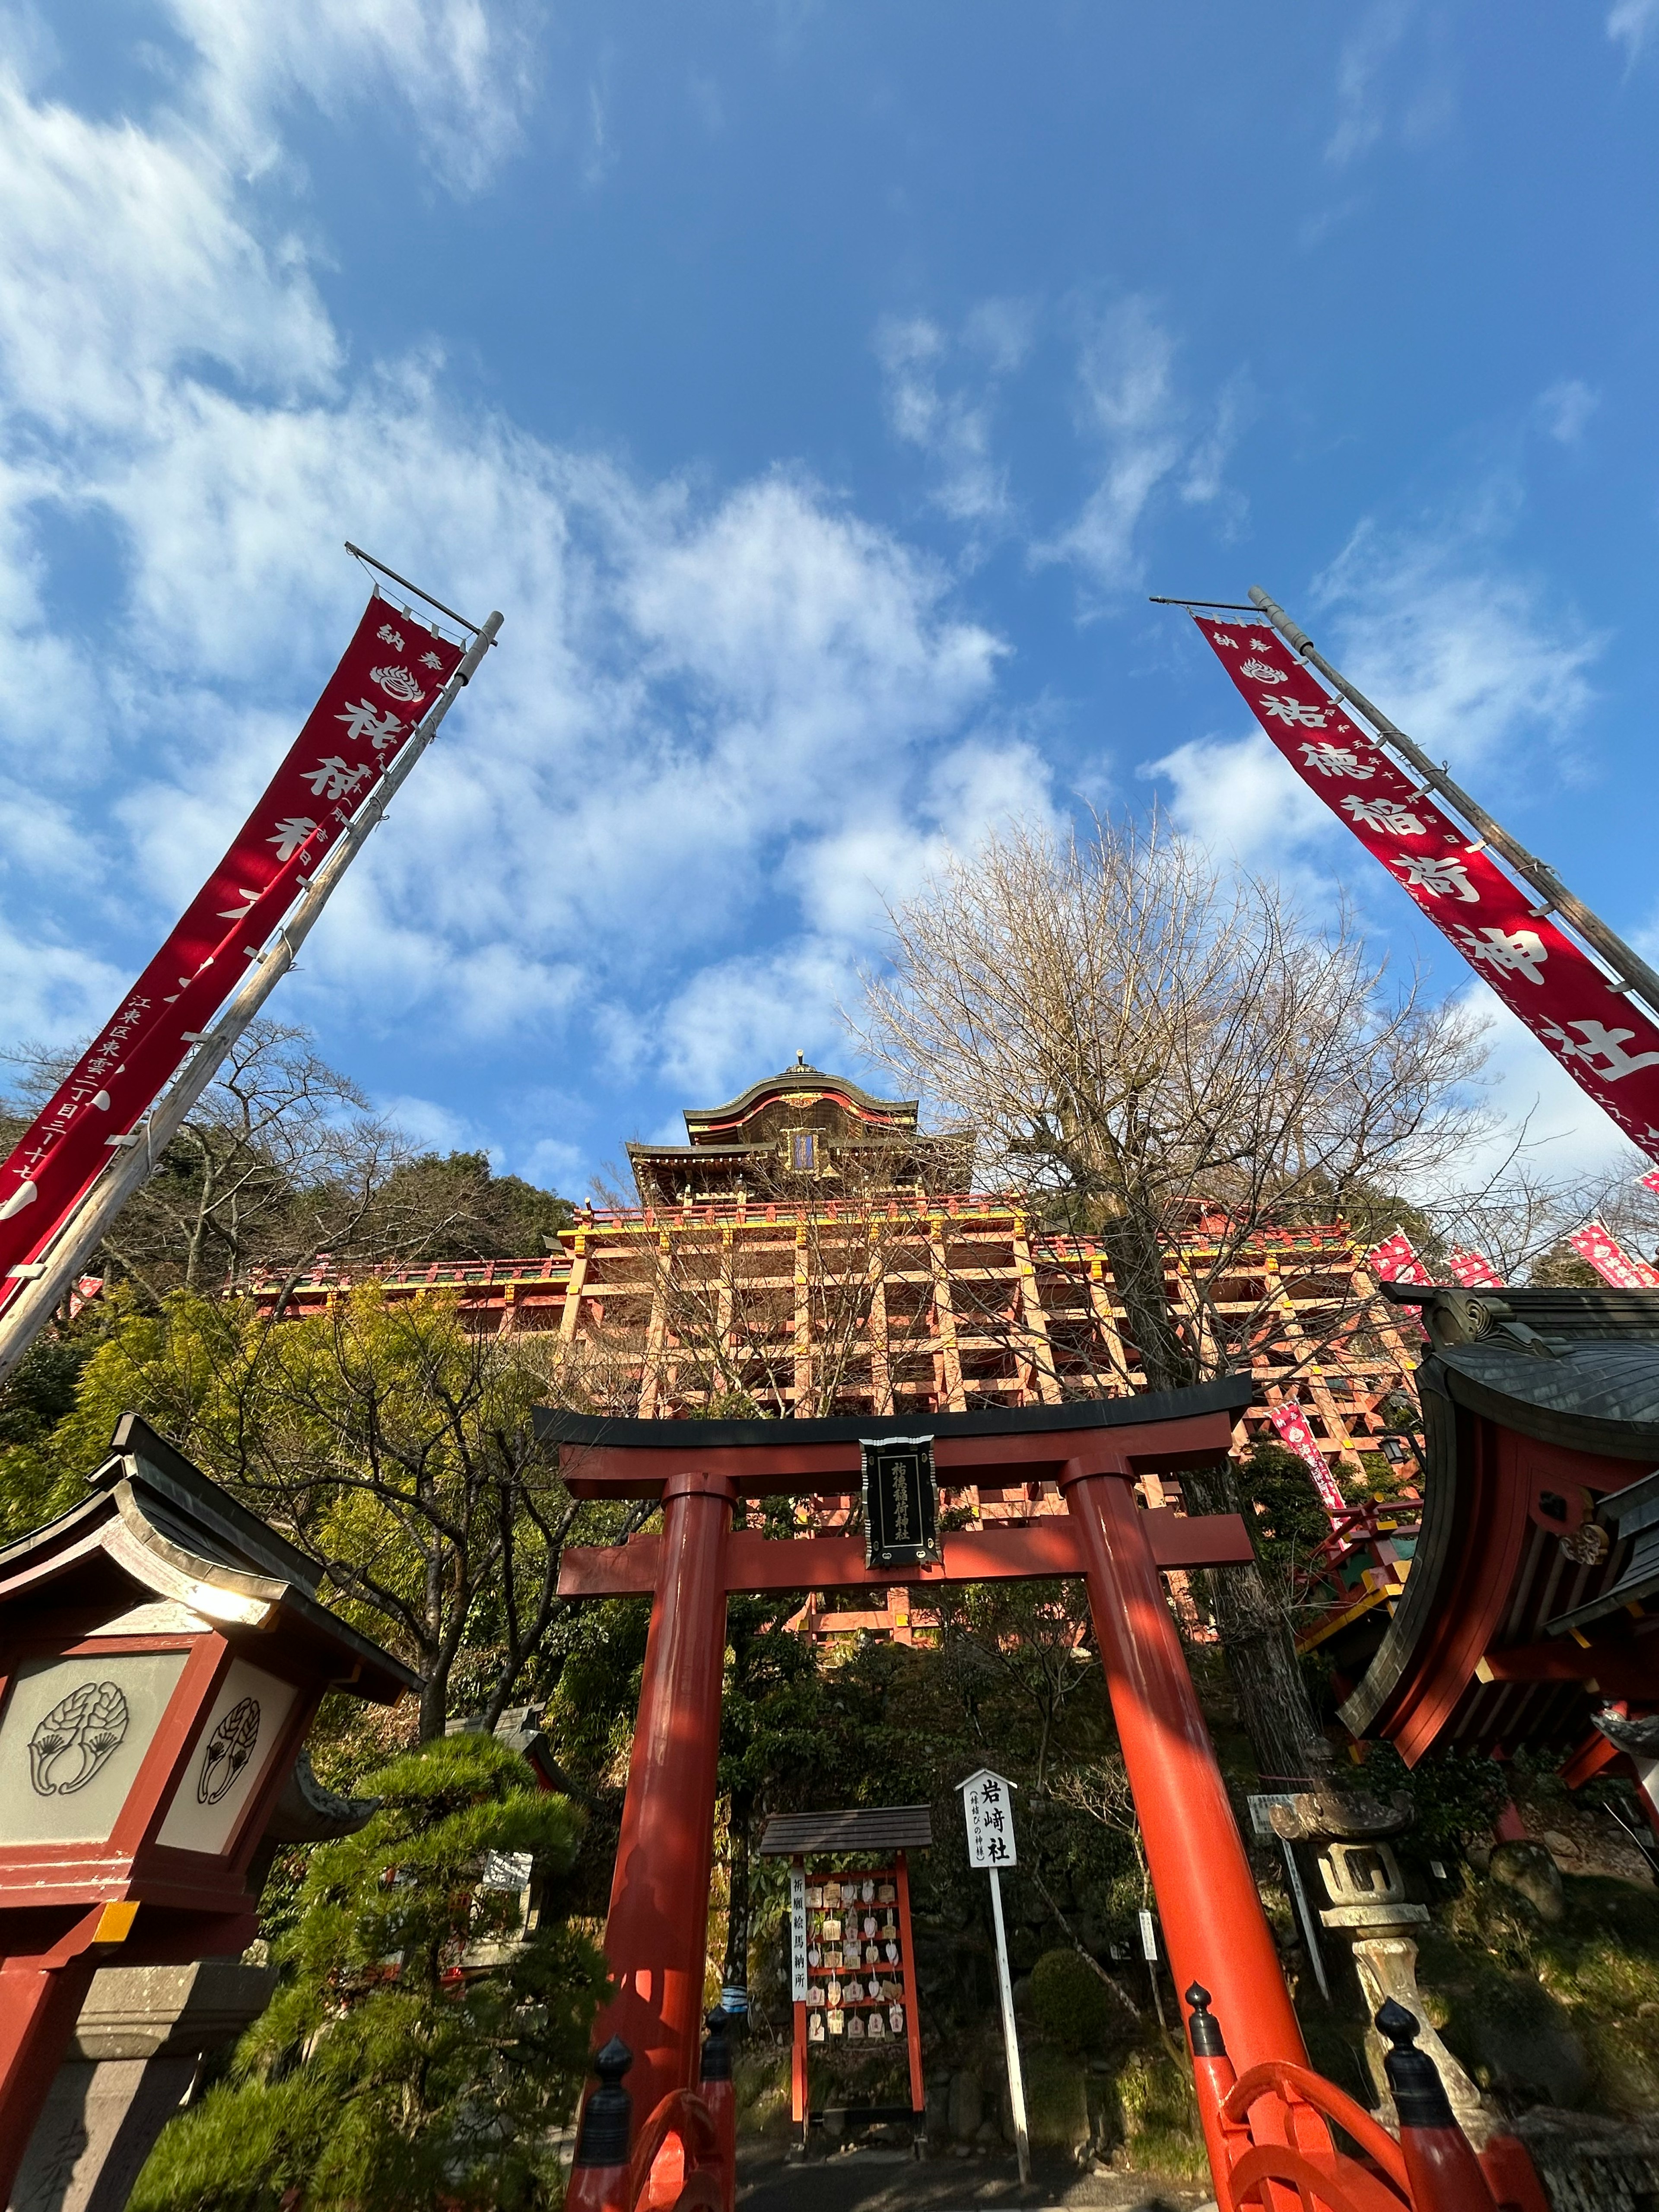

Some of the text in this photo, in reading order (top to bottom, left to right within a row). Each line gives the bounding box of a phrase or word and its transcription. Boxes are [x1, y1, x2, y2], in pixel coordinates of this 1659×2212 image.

[793, 1879, 804, 1988] 祈願絵馬納所
